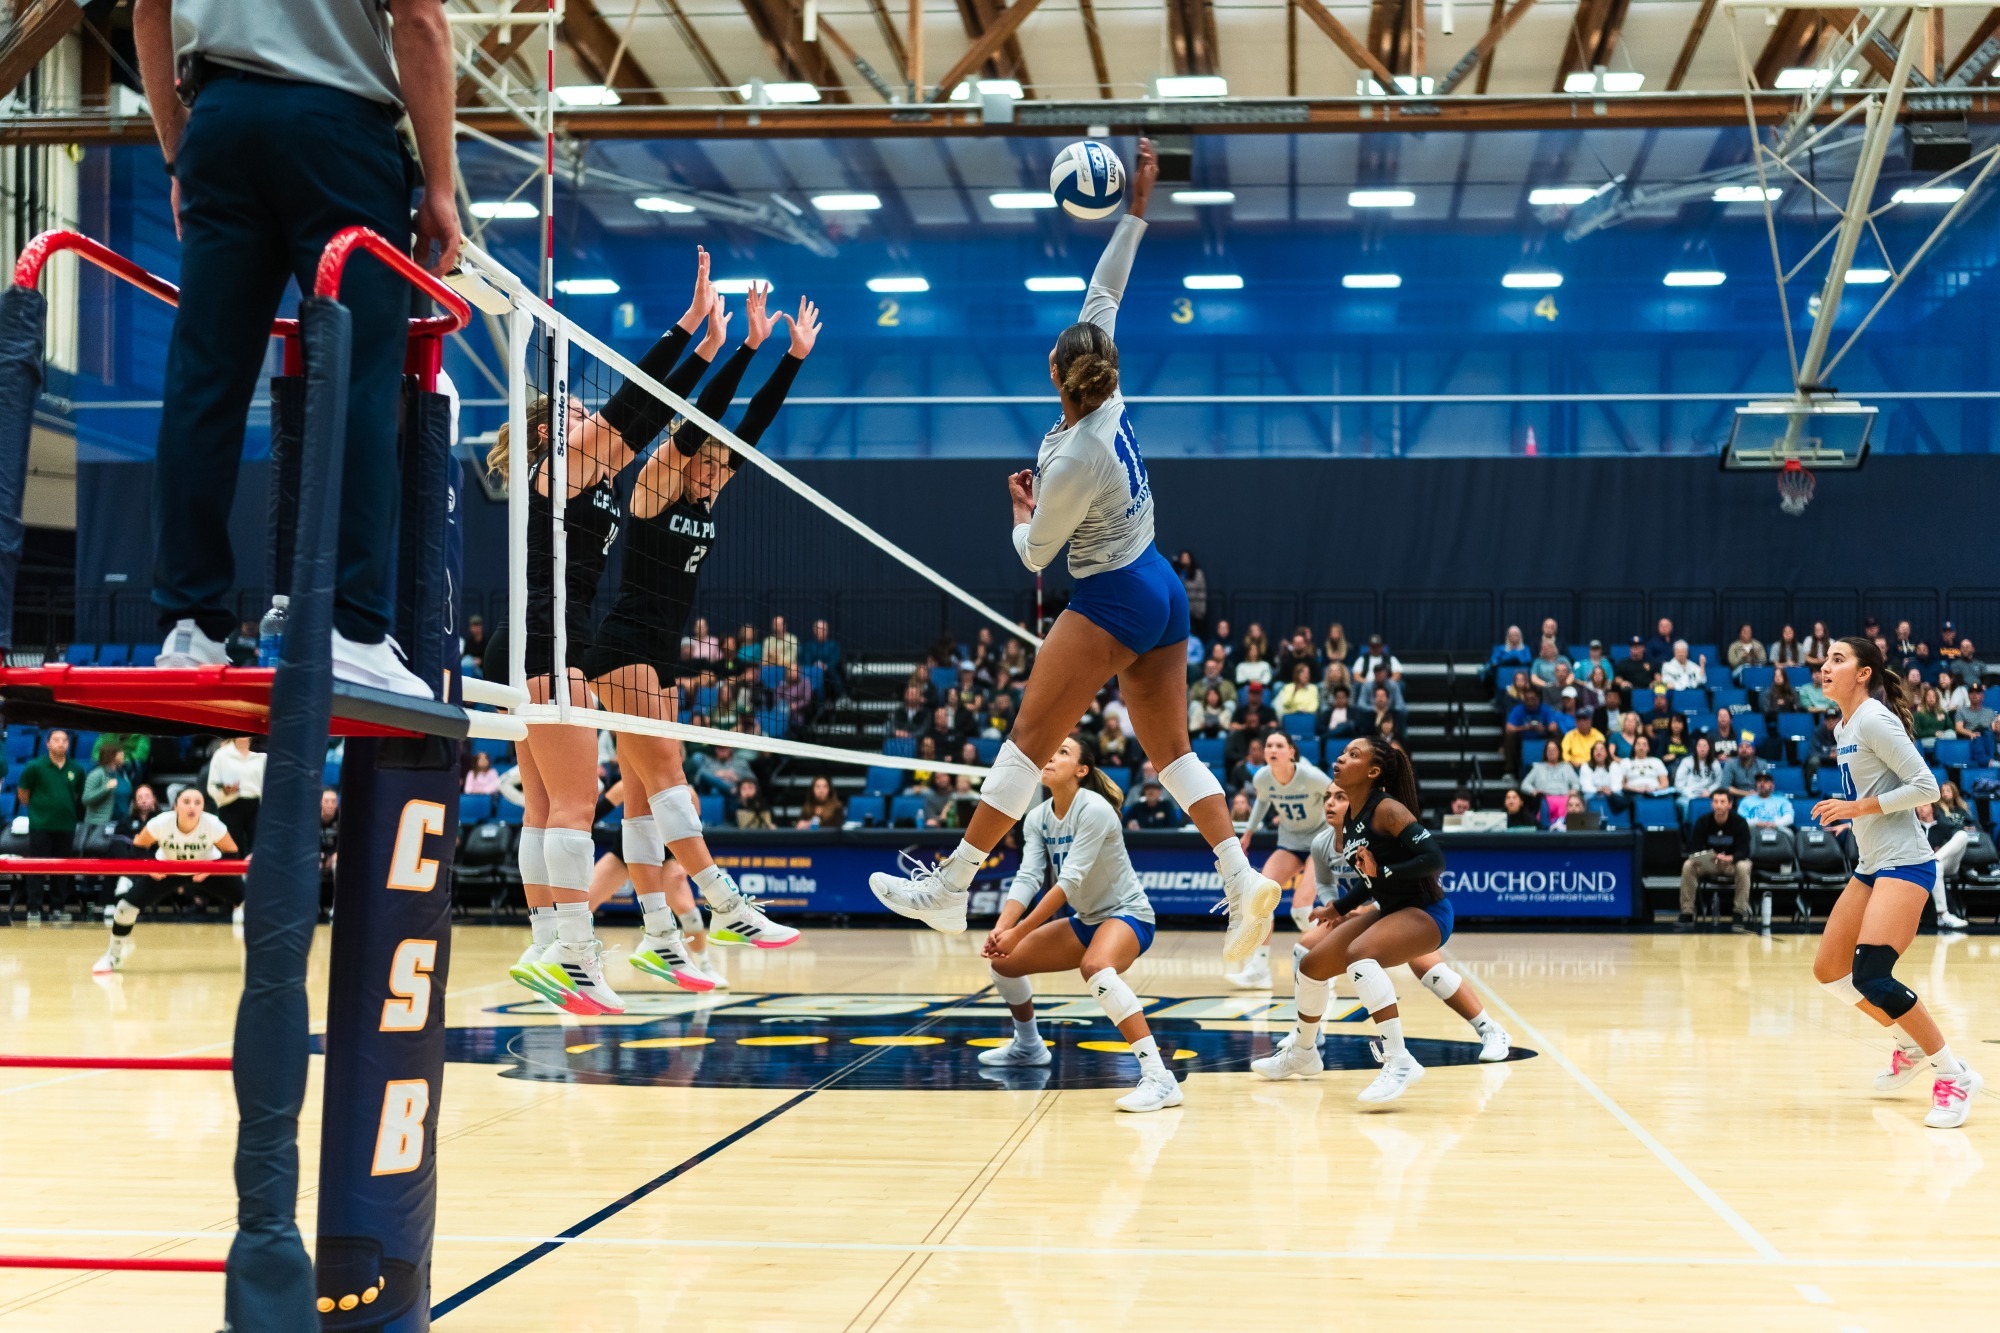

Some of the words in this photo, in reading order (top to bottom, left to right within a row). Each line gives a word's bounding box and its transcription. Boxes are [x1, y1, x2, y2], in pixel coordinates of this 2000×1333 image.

[1107, 151, 1117, 184] olten
[618, 302, 635, 328] 1
[877, 299, 899, 327] 2
[1171, 297, 1194, 324] 3
[1535, 294, 1559, 321] 4
[557, 395, 565, 457] Schelde
[669, 514, 700, 539] CAL
